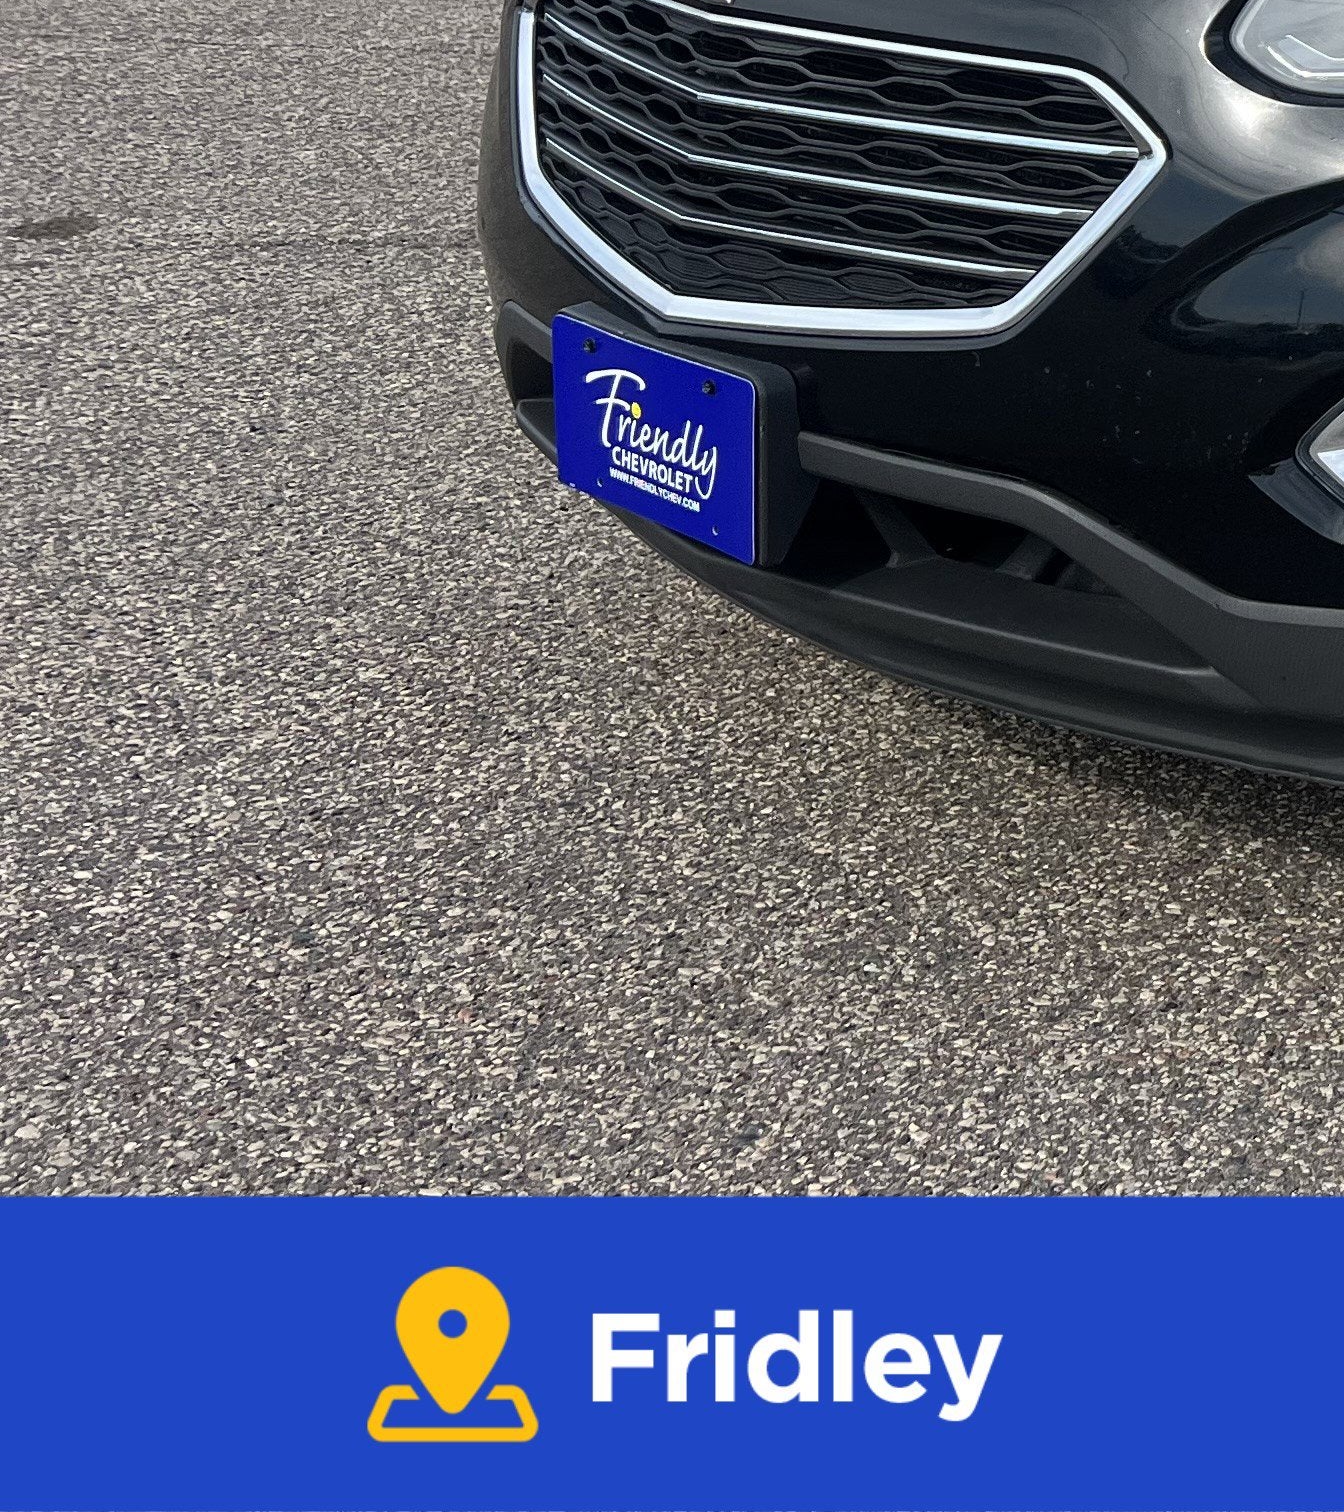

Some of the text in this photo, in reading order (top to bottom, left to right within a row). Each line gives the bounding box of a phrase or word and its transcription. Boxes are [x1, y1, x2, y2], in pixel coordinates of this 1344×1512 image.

[585, 369, 717, 500] Friendly
[609, 467, 700, 513] WWW.FRIENDLYCHEV.COM
[612, 445, 694, 493] CHEVROLET
